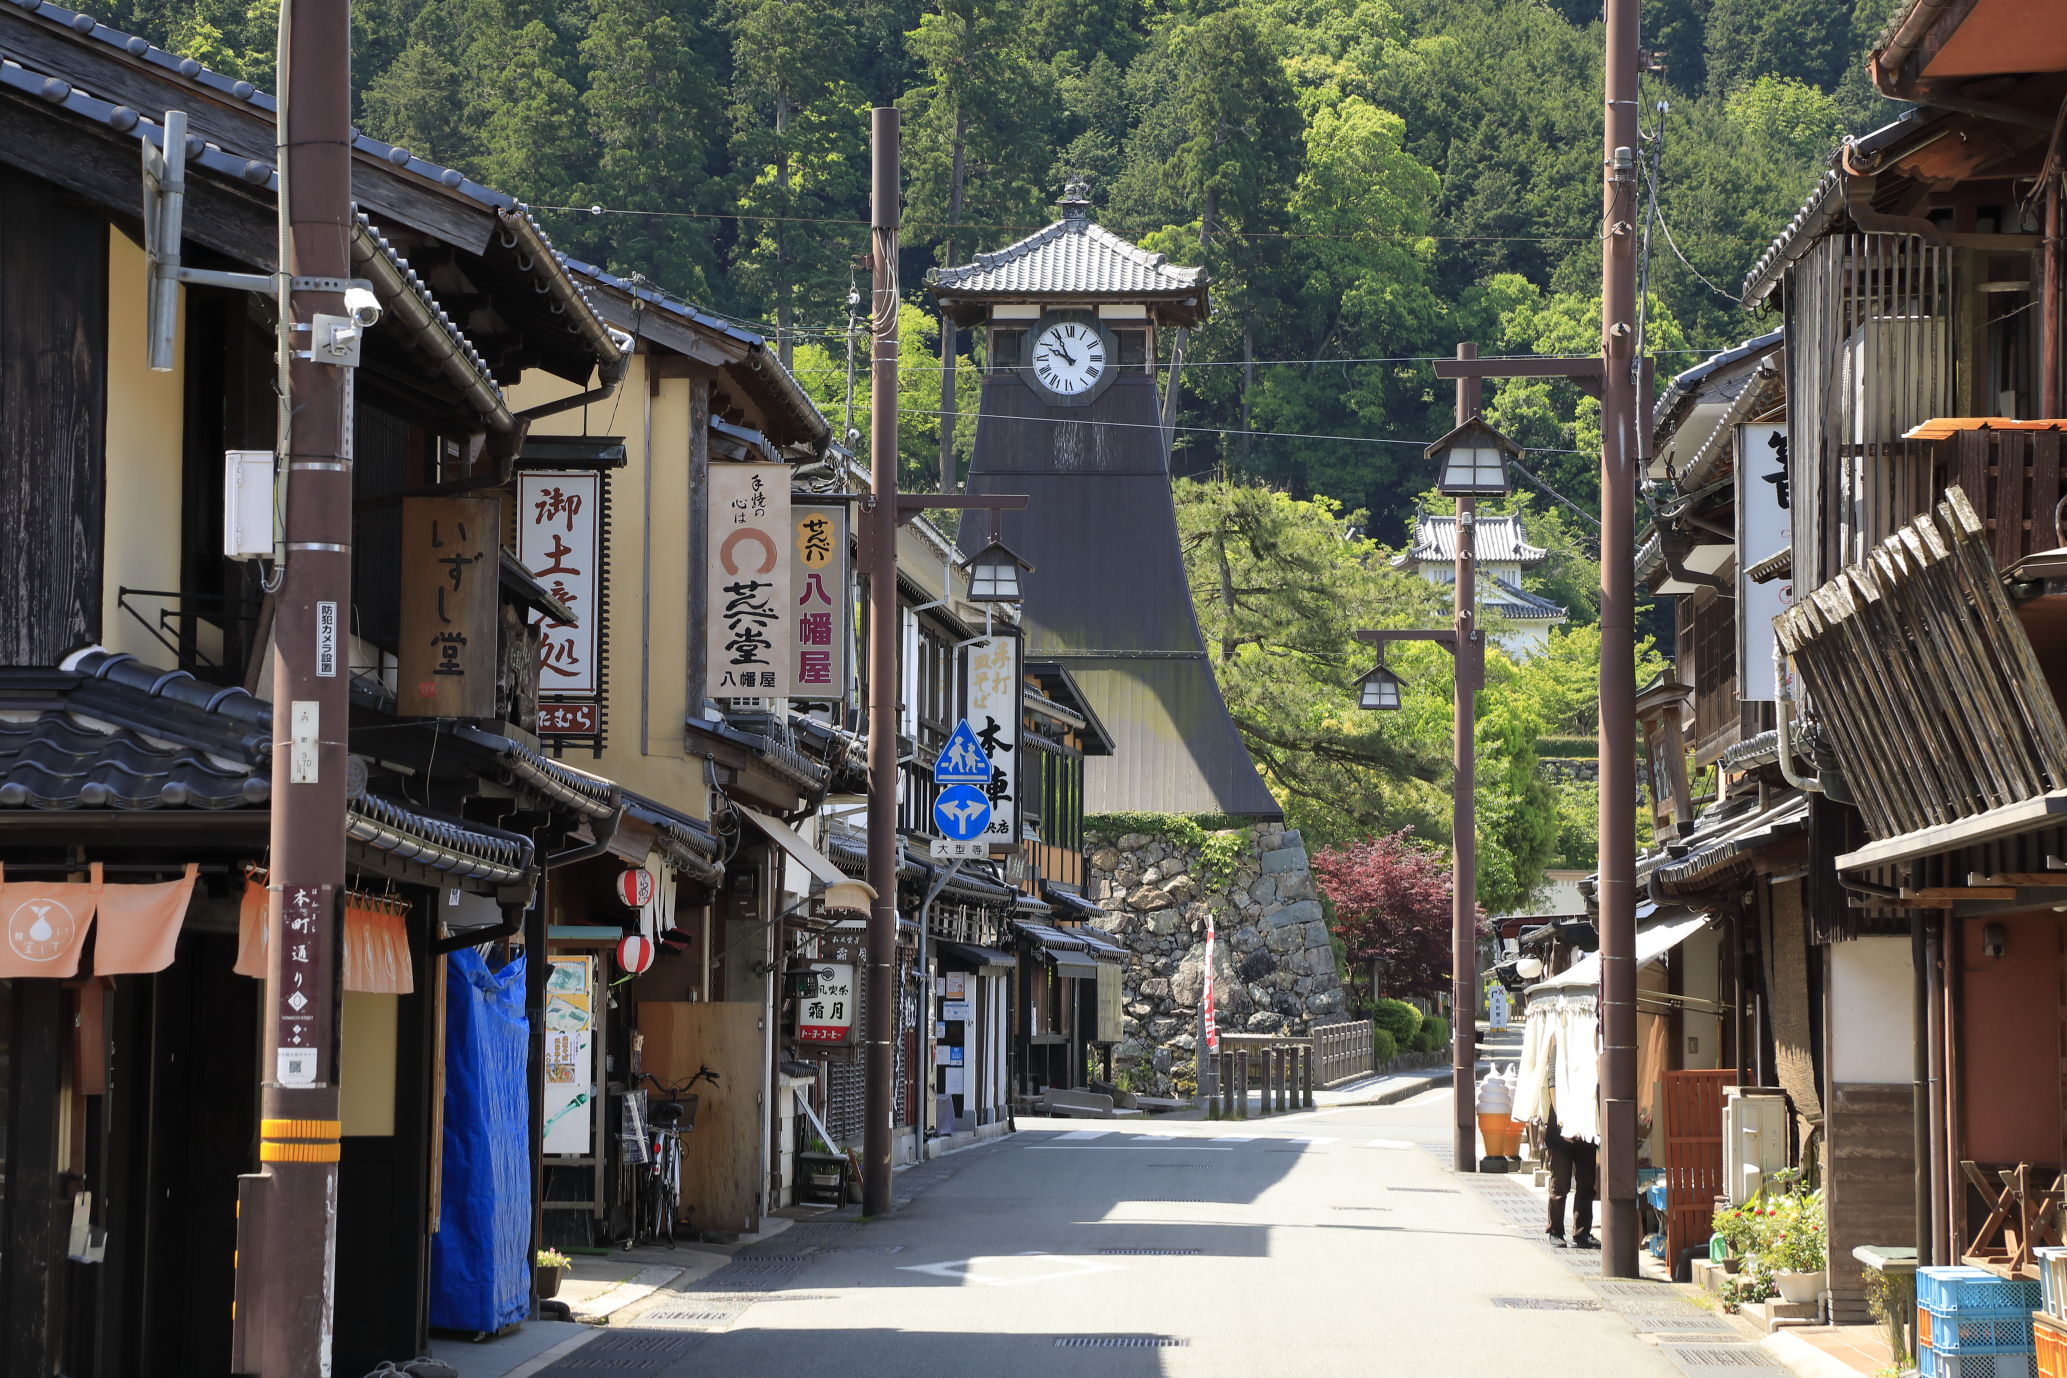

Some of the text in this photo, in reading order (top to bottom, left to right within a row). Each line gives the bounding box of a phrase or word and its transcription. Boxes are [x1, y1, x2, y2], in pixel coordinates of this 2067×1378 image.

[802, 519, 830, 562] せんべい
[430, 519, 484, 676] いずし堂
[321, 605, 333, 673] 防犯カメラ設置
[722, 580, 780, 665] せんべい堂
[798, 573, 832, 684] 八幡屋
[720, 671, 776, 688] 八幡屋
[972, 653, 993, 710] 皿そば
[991, 640, 1012, 696] 手打
[539, 706, 591, 730] たむら
[937, 844, 983, 856] 大型等
[291, 888, 310, 988] 本町通り
[836, 947, 867, 962] 霜月
[808, 1001, 844, 1020] 霜月
[818, 984, 849, 996] 風喫茶
[801, 1029, 842, 1040] トーヨーコーヒー
